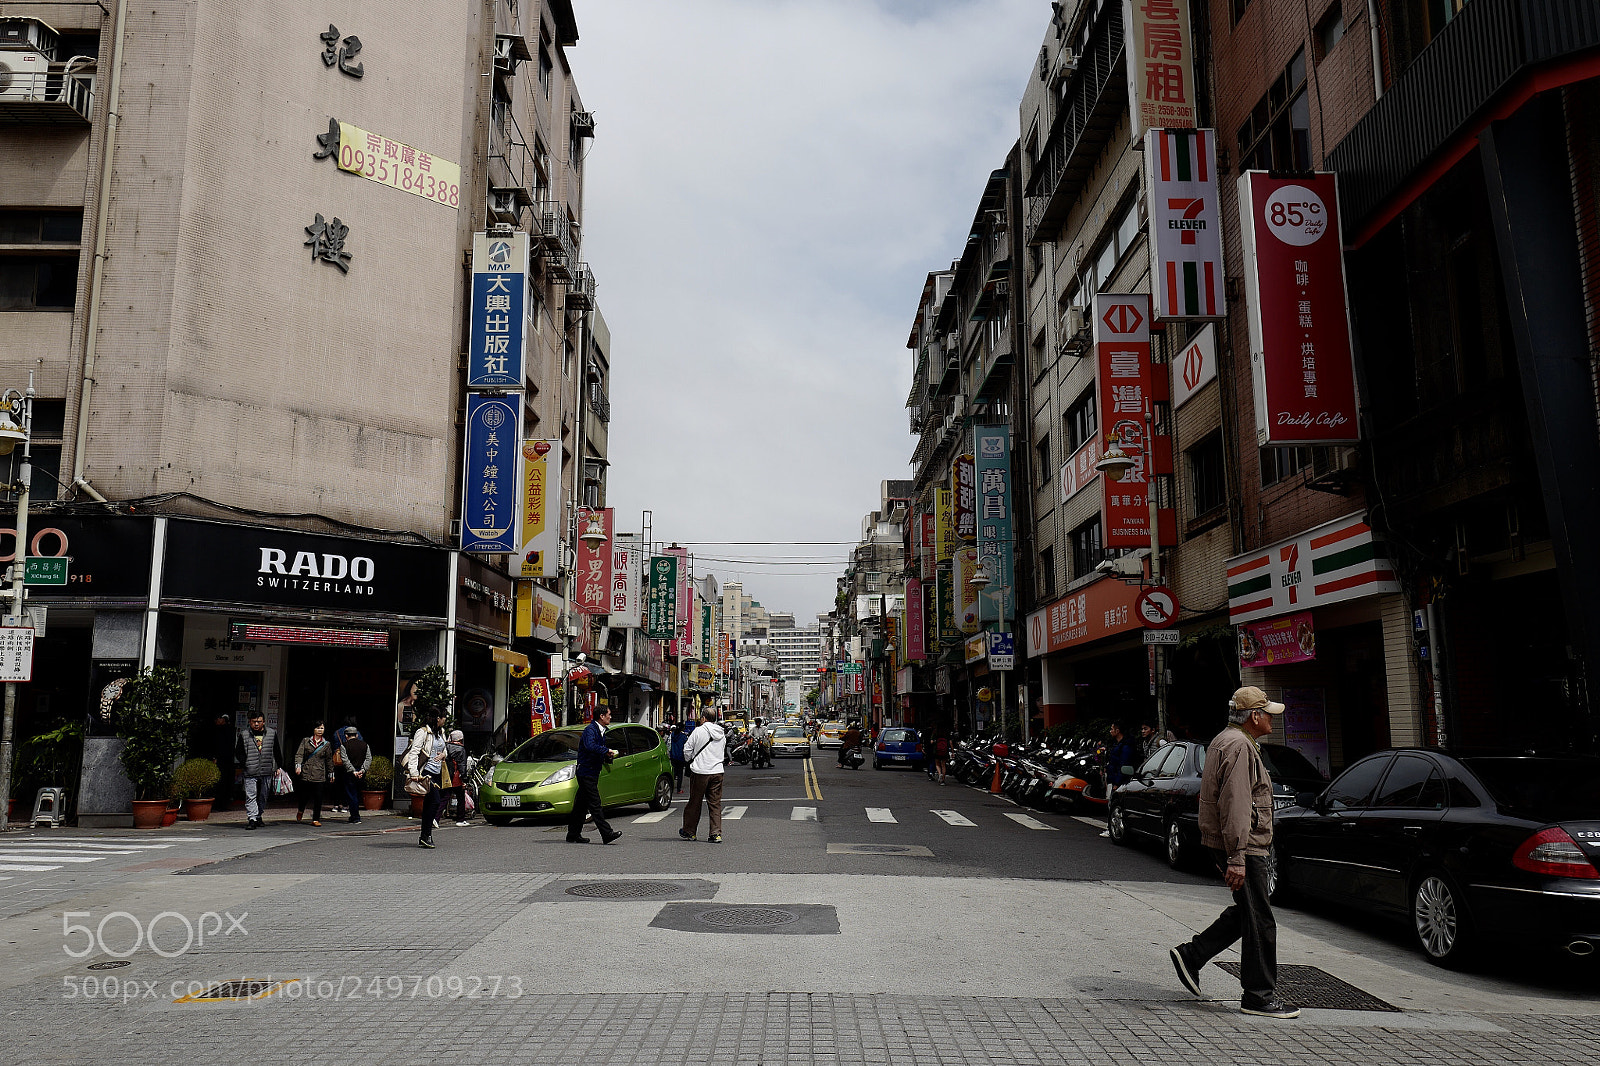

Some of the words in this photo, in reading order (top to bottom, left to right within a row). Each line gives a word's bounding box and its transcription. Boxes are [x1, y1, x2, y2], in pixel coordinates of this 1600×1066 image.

[367, 133, 432, 172] 宗取廣告
[341, 144, 459, 207] 0935184388
[488, 263, 511, 271] MAP
[1277, 411, 1315, 428] Daily
[1316, 411, 1348, 428] Cafe
[481, 432, 500, 528] 美中鐘錶公司
[527, 468, 542, 525] 公益彩券
[1112, 527, 1139, 536] BUSINESS
[258, 547, 375, 582] RADO
[257, 576, 374, 595] SWITZERLAND
[1051, 593, 1087, 634] 臺灣企銀
[1104, 605, 1128, 629] 萬華分行
[991, 633, 1002, 648] P
